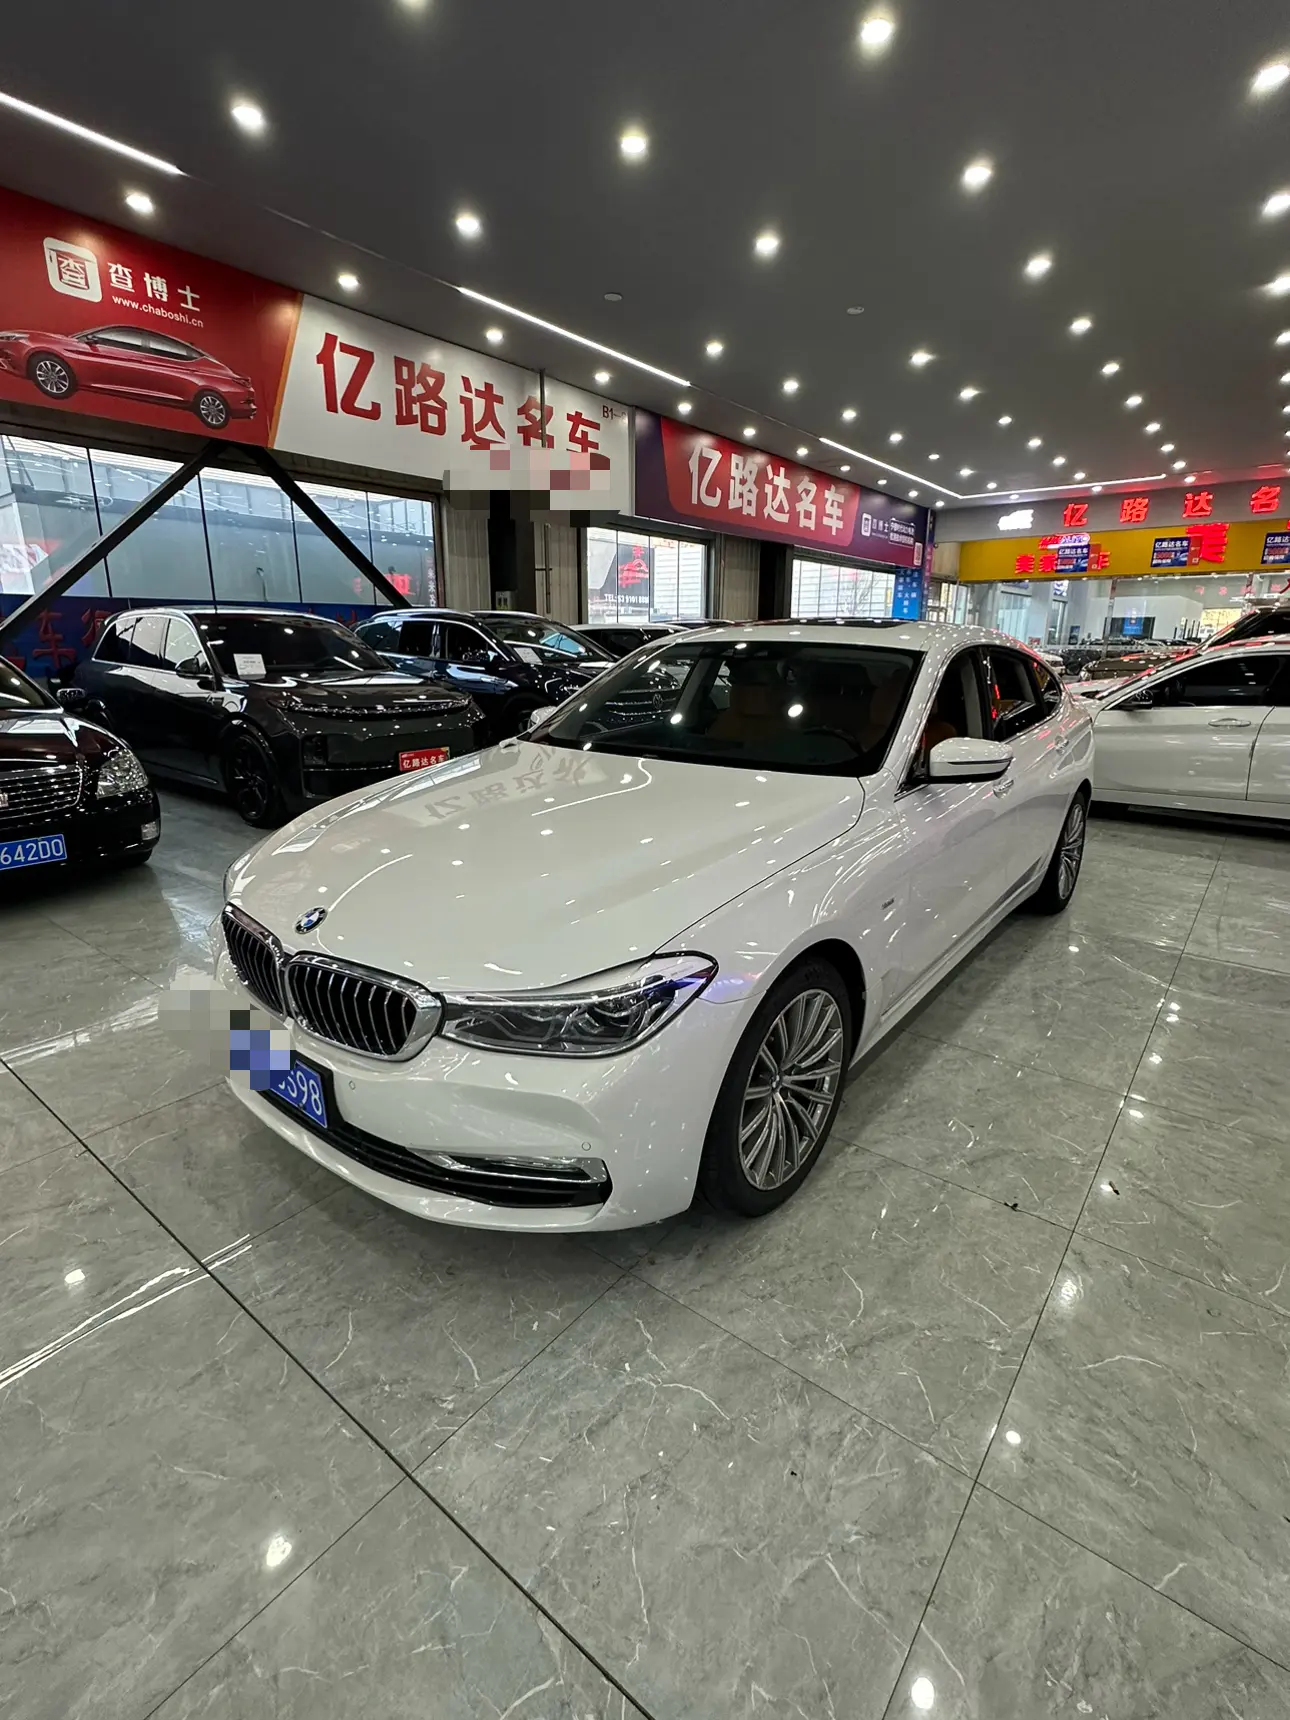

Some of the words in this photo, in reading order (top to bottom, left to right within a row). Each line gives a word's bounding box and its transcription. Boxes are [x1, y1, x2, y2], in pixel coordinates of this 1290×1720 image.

[107, 262, 201, 312] 查博士
[112, 295, 204, 328] www.chaboshi.cn
[316, 332, 601, 453] 亿路达名车
[688, 445, 845, 536] 亿路达名车
[1063, 486, 1281, 528] 亿路达名
